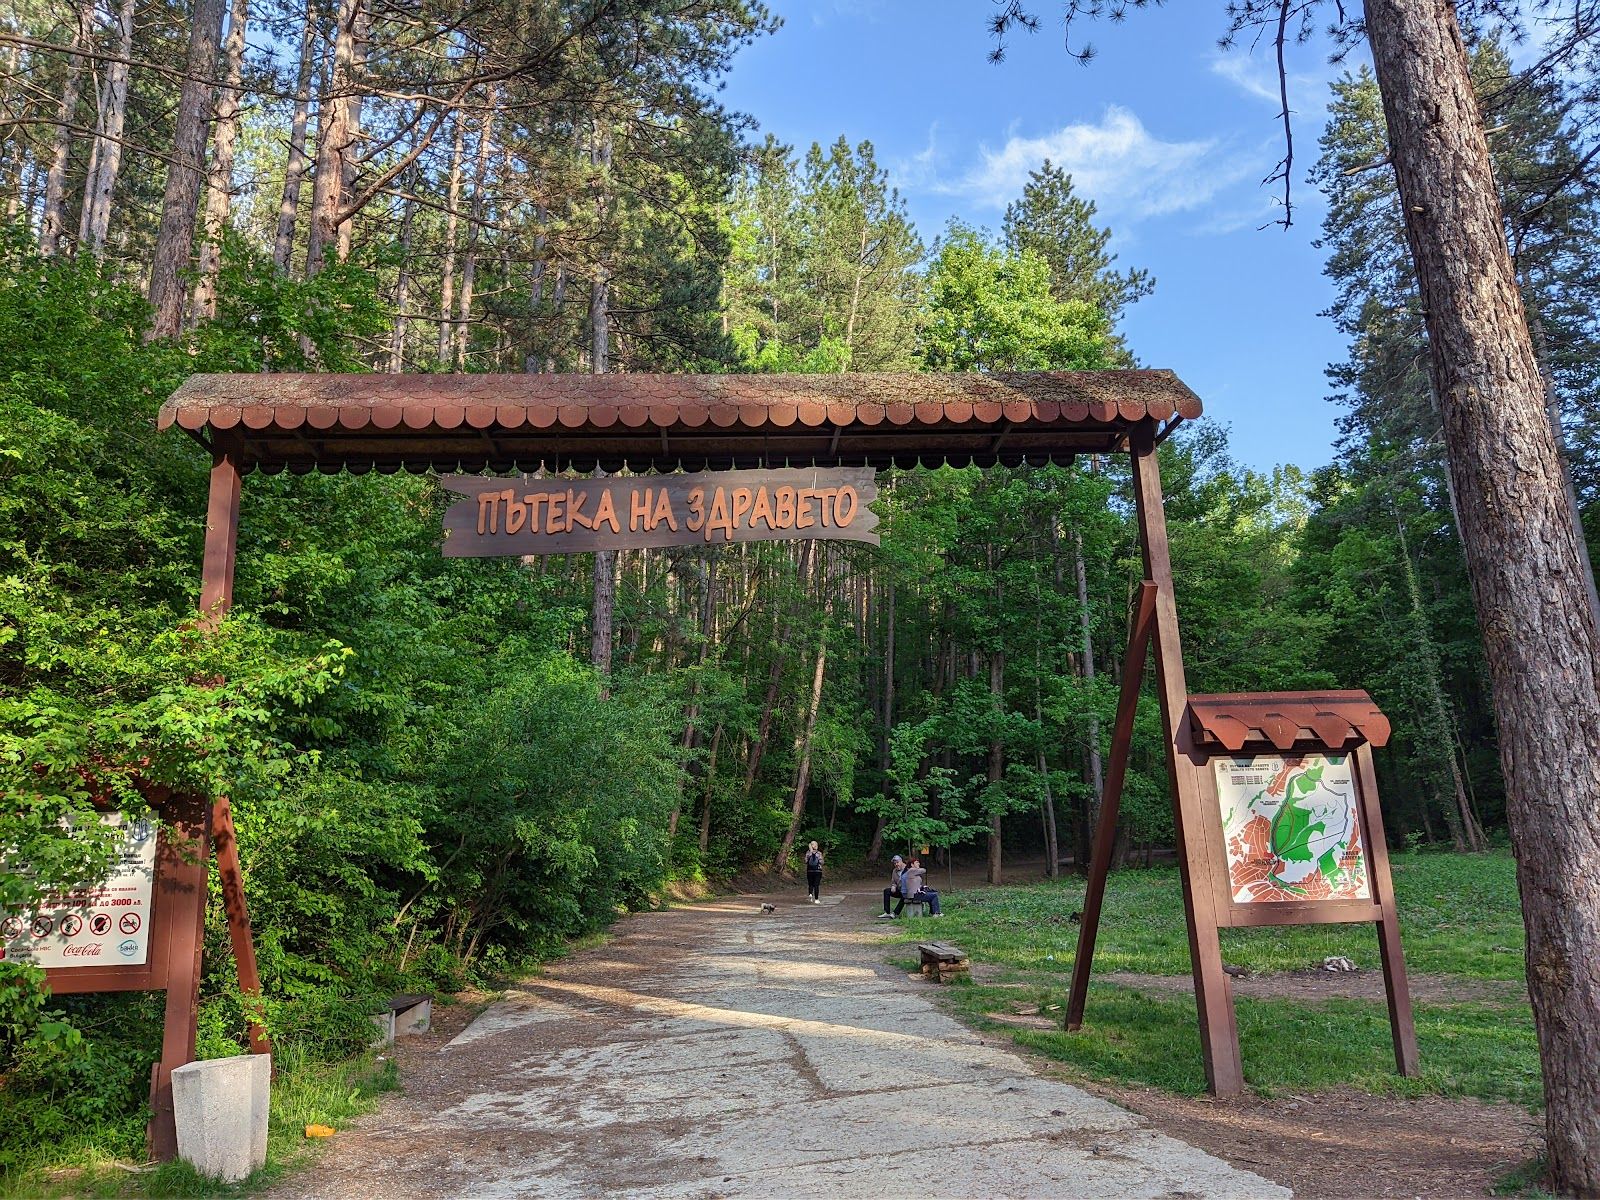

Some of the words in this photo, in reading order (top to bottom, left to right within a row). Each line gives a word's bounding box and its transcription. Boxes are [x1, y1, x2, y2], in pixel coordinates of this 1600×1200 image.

[477, 488, 621, 536] ПЪТЕКА
[630, 487, 677, 532] НА
[686, 485, 858, 541] ЗДРАВЕТО
[111, 898, 132, 906] 3000
